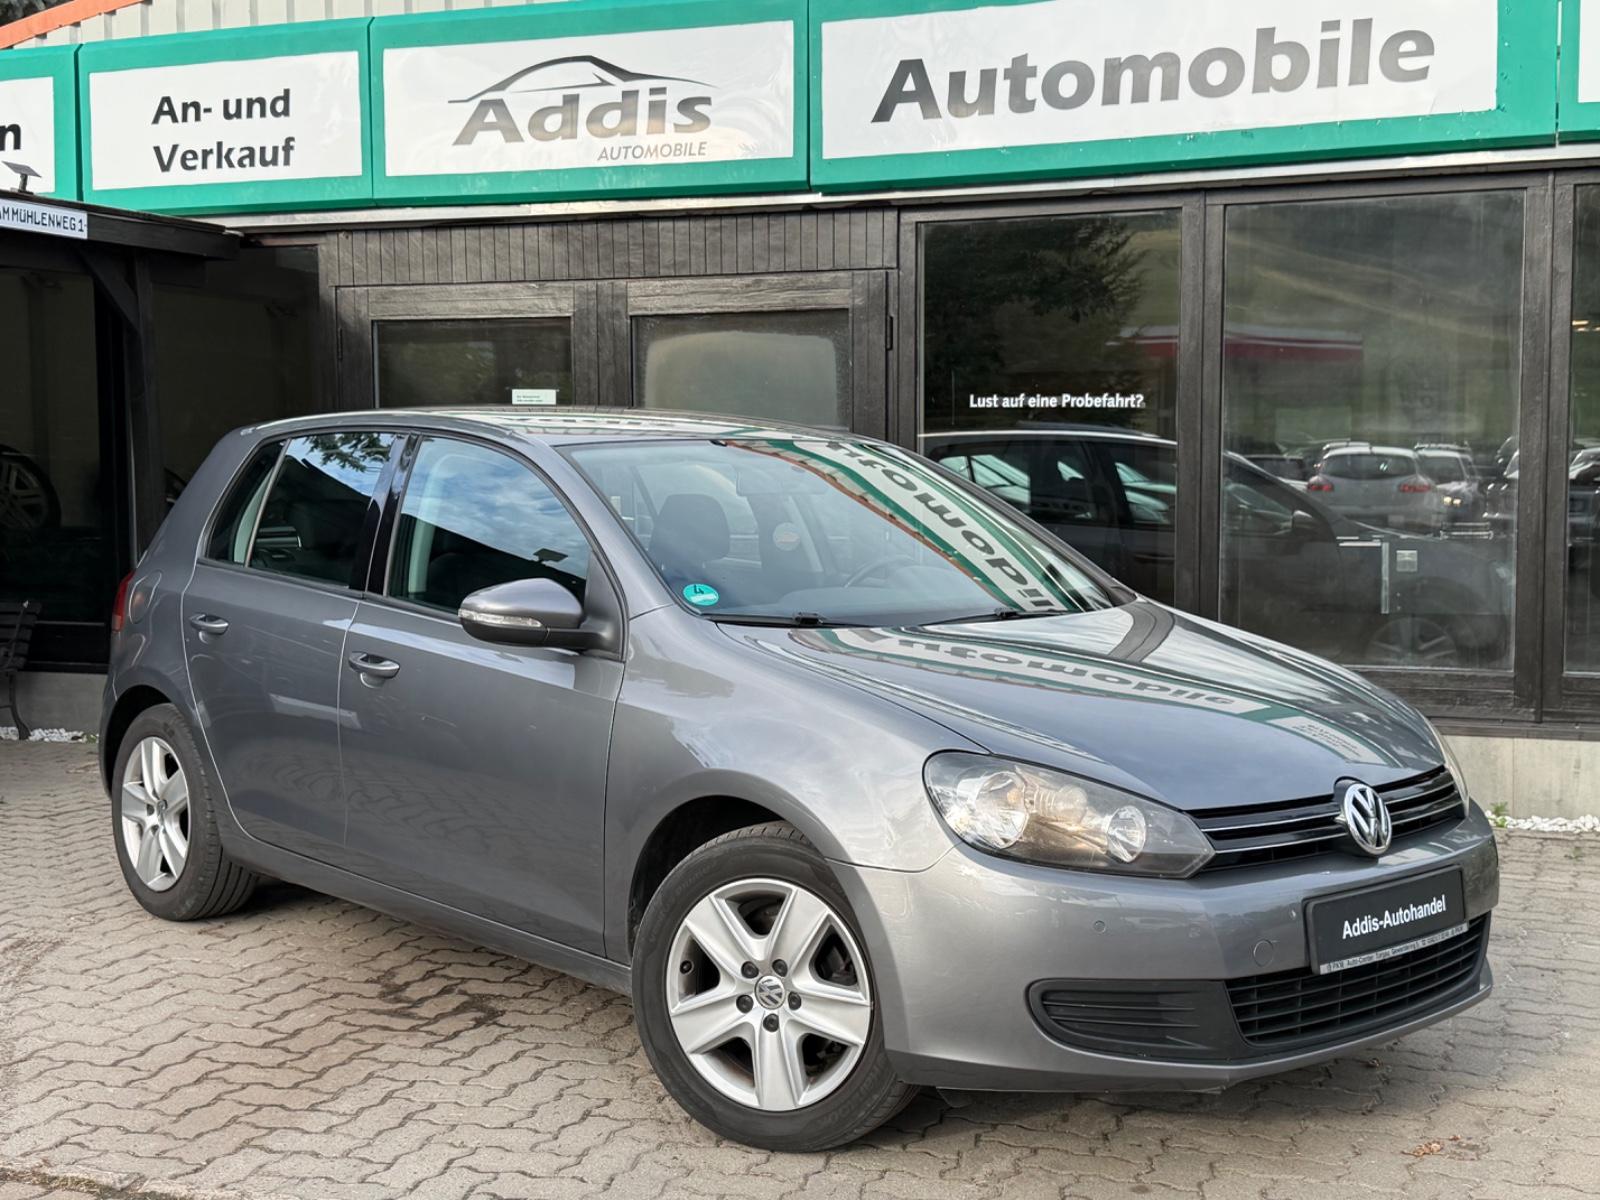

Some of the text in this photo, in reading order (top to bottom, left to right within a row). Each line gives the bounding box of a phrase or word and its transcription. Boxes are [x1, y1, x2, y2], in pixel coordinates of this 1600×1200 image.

[871, 18, 1436, 124] Automobile
[151, 88, 291, 125] An- und
[451, 87, 713, 146] Addis
[153, 137, 296, 172] Verkauf
[597, 141, 708, 162] AUTOMOBILE
[969, 393, 1145, 409] Lust auf eine Probefahrt?
[693, 584, 705, 595] 4
[1342, 894, 1447, 940] Addis-Autohandel
